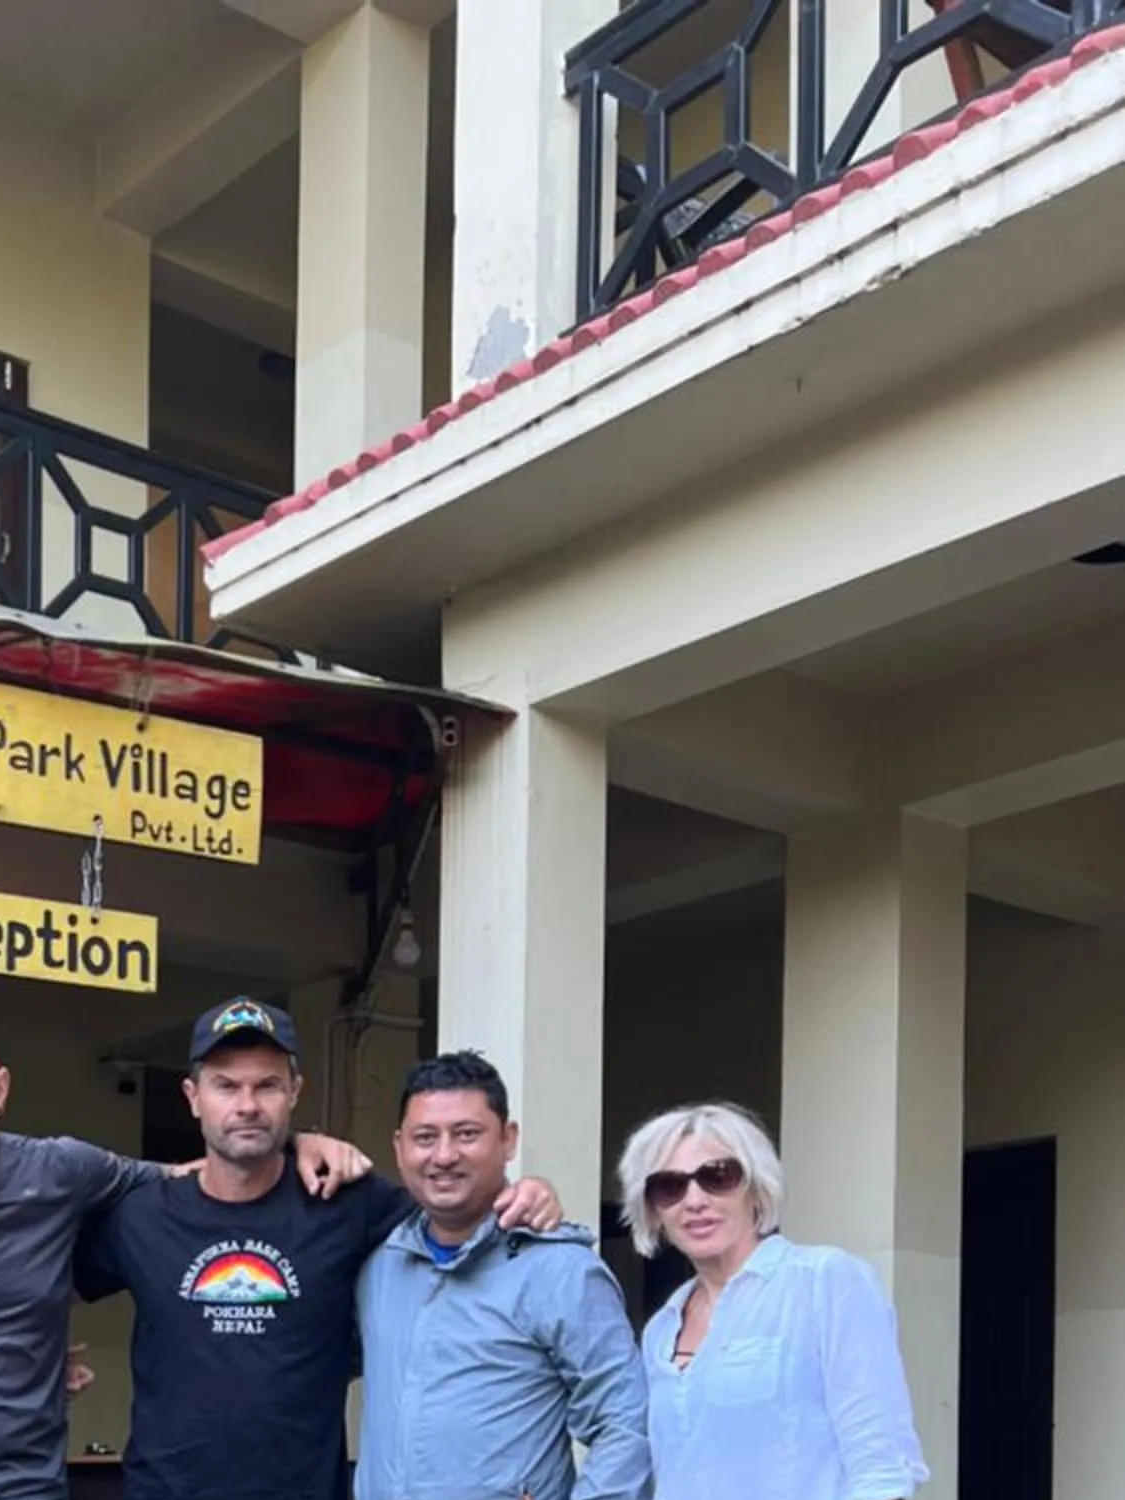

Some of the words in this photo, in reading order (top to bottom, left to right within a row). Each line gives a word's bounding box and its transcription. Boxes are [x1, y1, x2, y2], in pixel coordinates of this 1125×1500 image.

[99, 739, 252, 819] Village
[277, 1258, 301, 1298] CAMP
[203, 1304, 276, 1320] POKHARA
[211, 1319, 267, 1335] NEPAL
